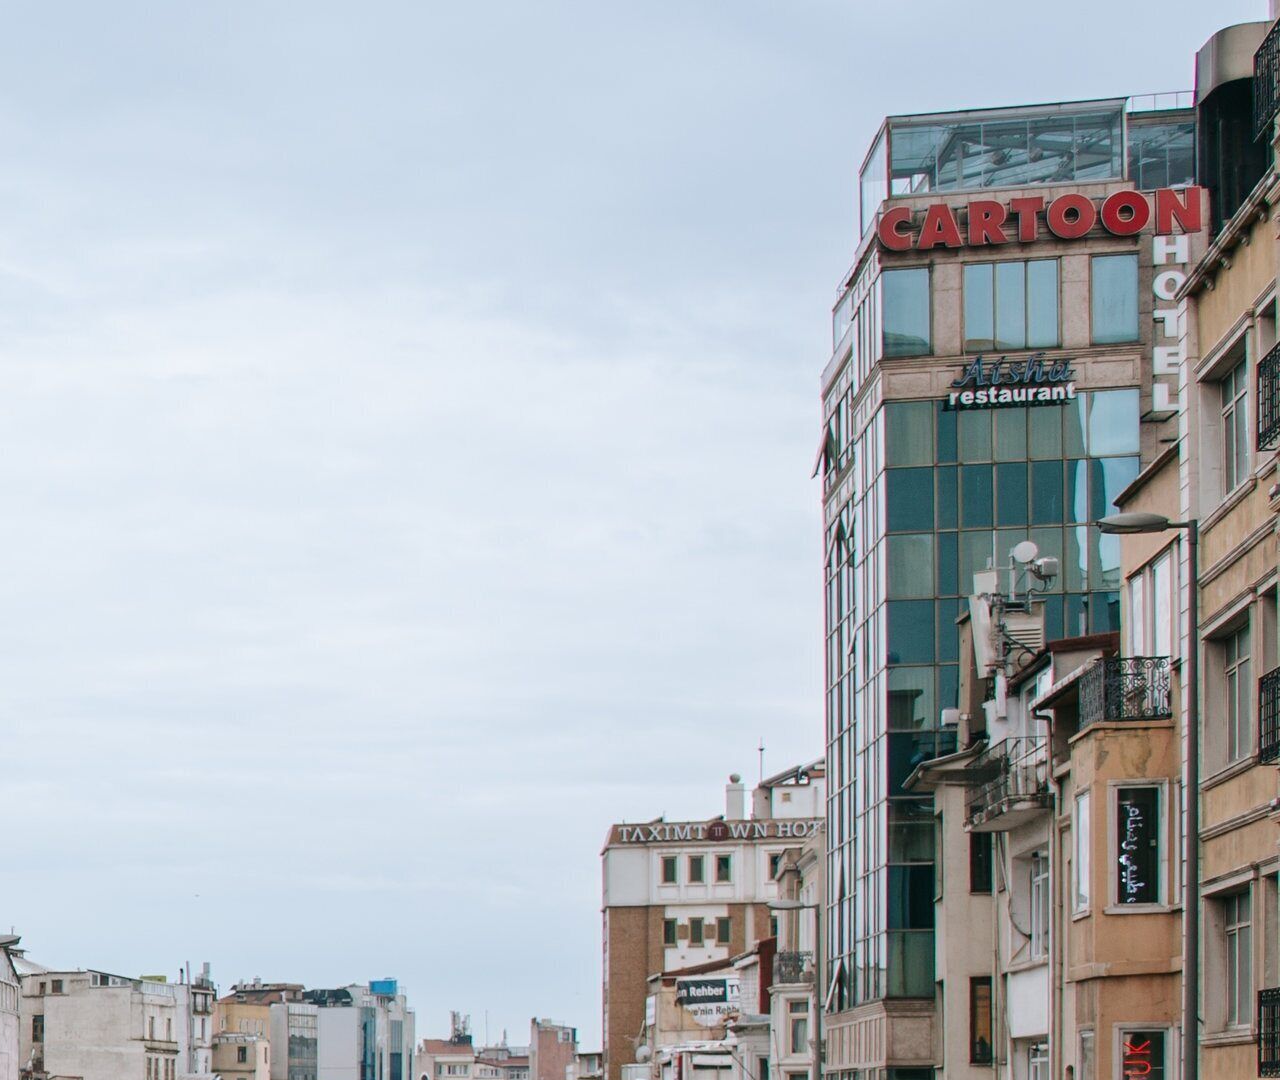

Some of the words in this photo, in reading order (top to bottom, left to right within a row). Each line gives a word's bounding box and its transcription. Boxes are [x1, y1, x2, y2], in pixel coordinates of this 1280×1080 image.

[878, 185, 1202, 250] CARTOON
[1153, 235, 1189, 411] HOTEL
[953, 352, 1071, 388] Aisha
[949, 383, 1076, 406] restaurant
[689, 986, 724, 997] Rehber
